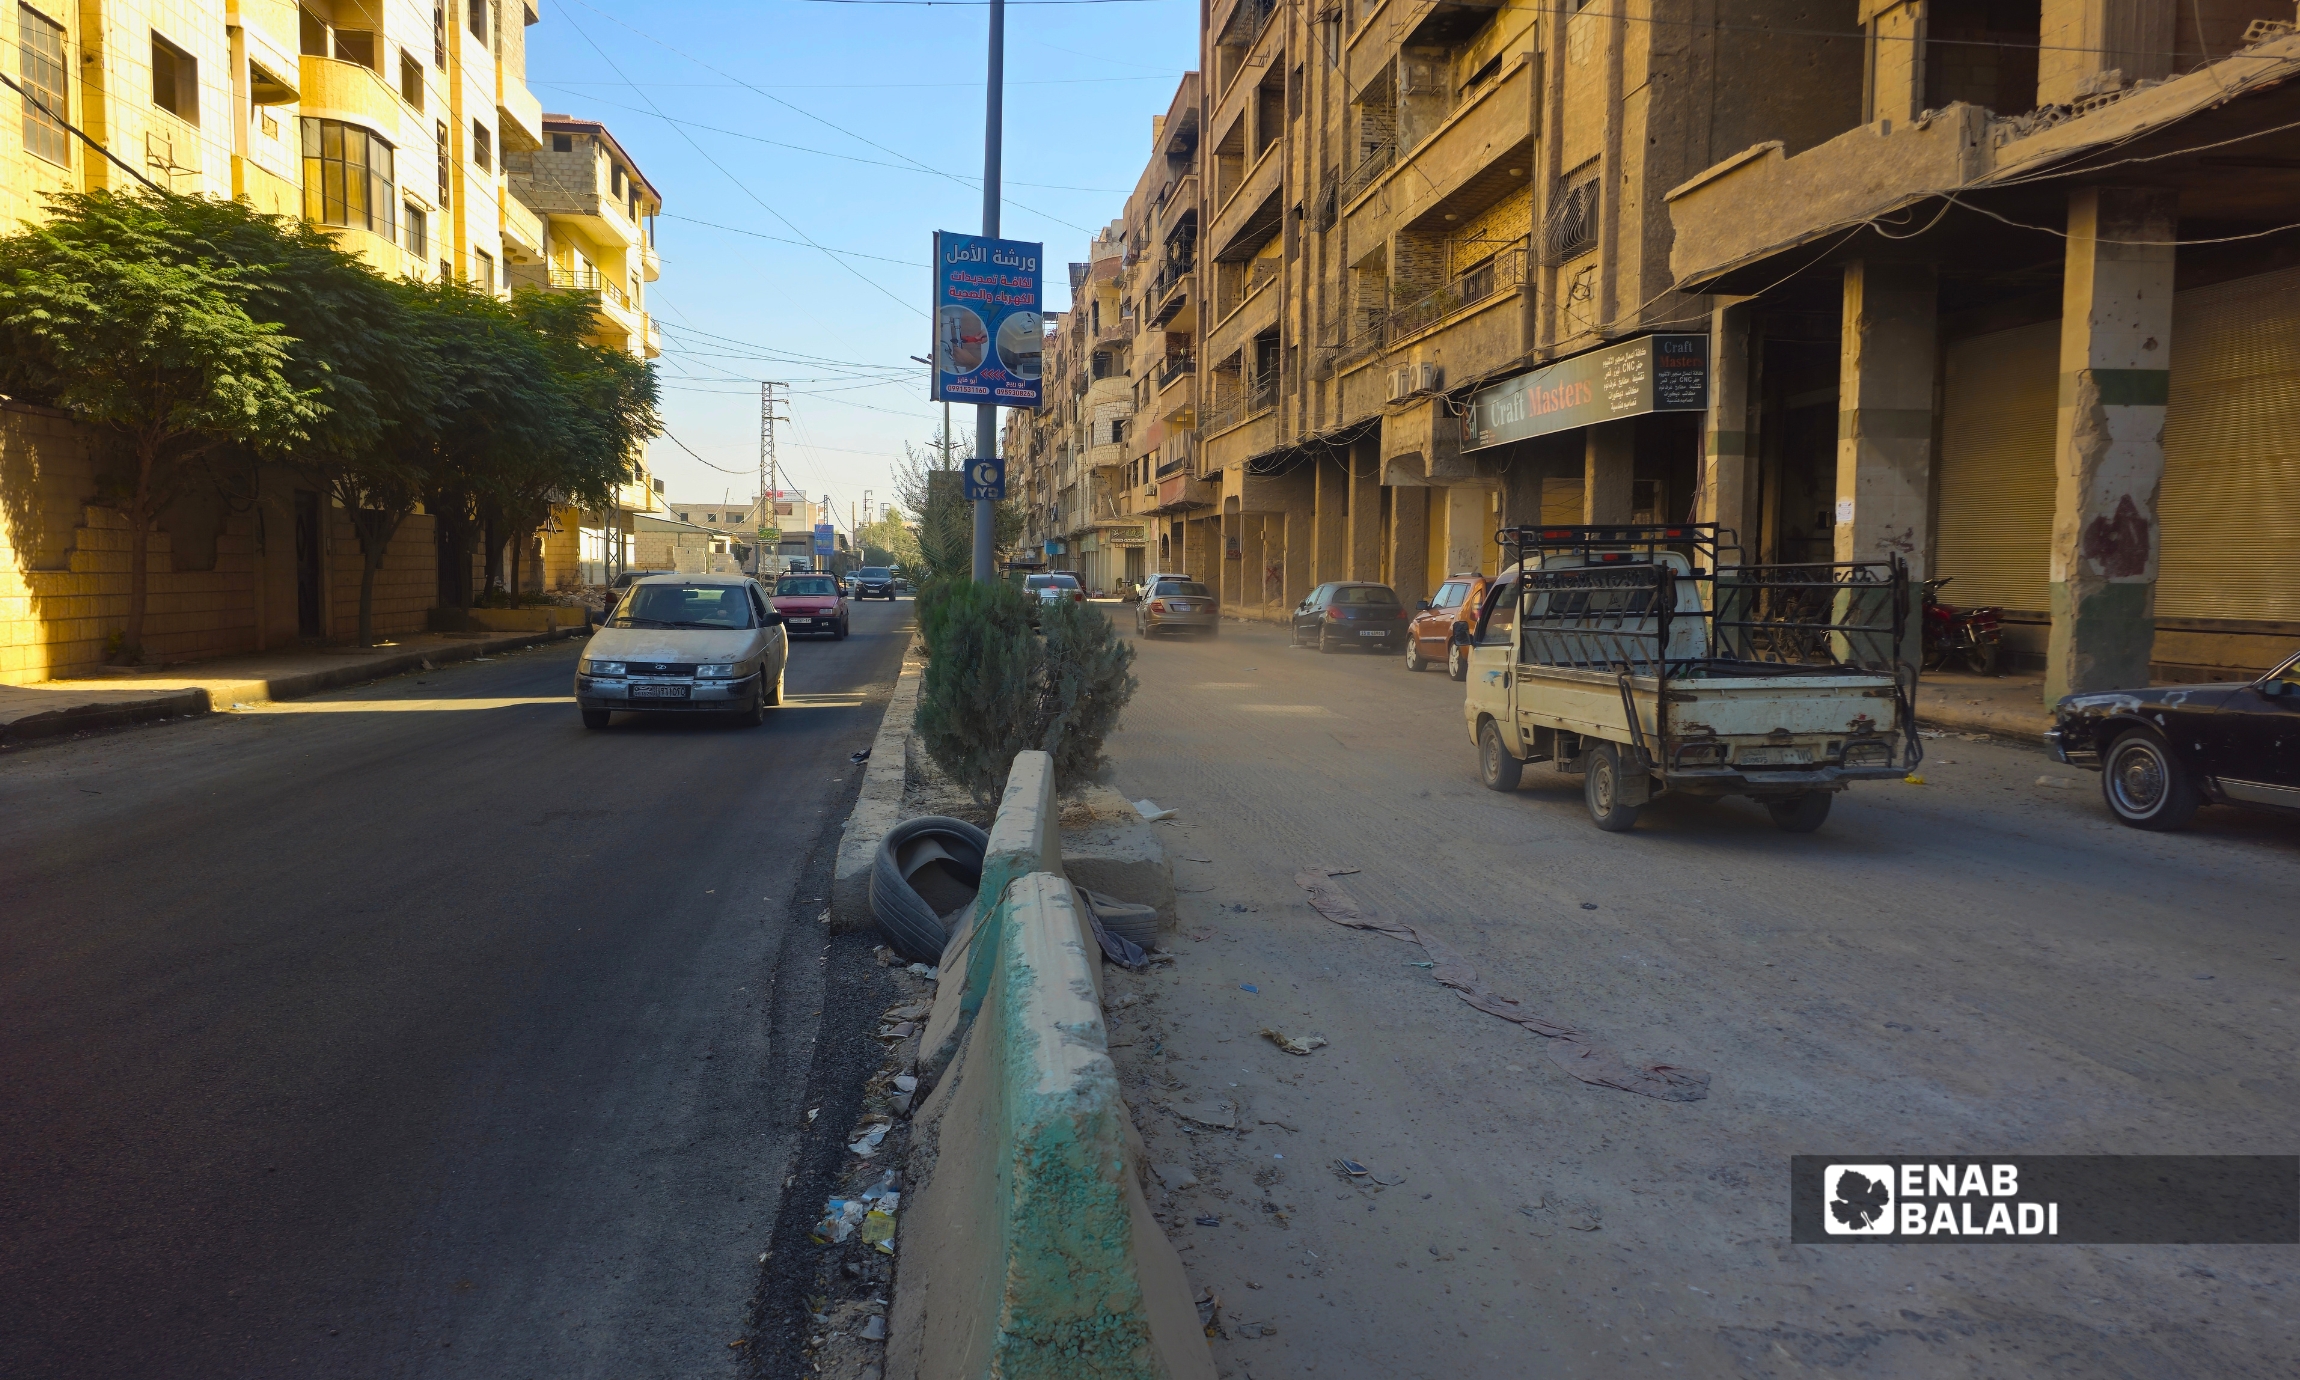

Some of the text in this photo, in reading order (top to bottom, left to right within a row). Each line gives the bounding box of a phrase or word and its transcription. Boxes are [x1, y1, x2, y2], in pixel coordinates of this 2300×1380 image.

[946, 244, 1036, 272] ورشة الأمل
[951, 271, 1032, 288] لكافة تمديدات
[949, 286, 1034, 306] الكهرباء والصحية
[1664, 341, 1693, 353] Craft
[1622, 361, 1635, 373] CNC
[1659, 355, 1704, 367] Masters
[1491, 391, 1525, 427] Craft
[1527, 379, 1592, 418] Masters
